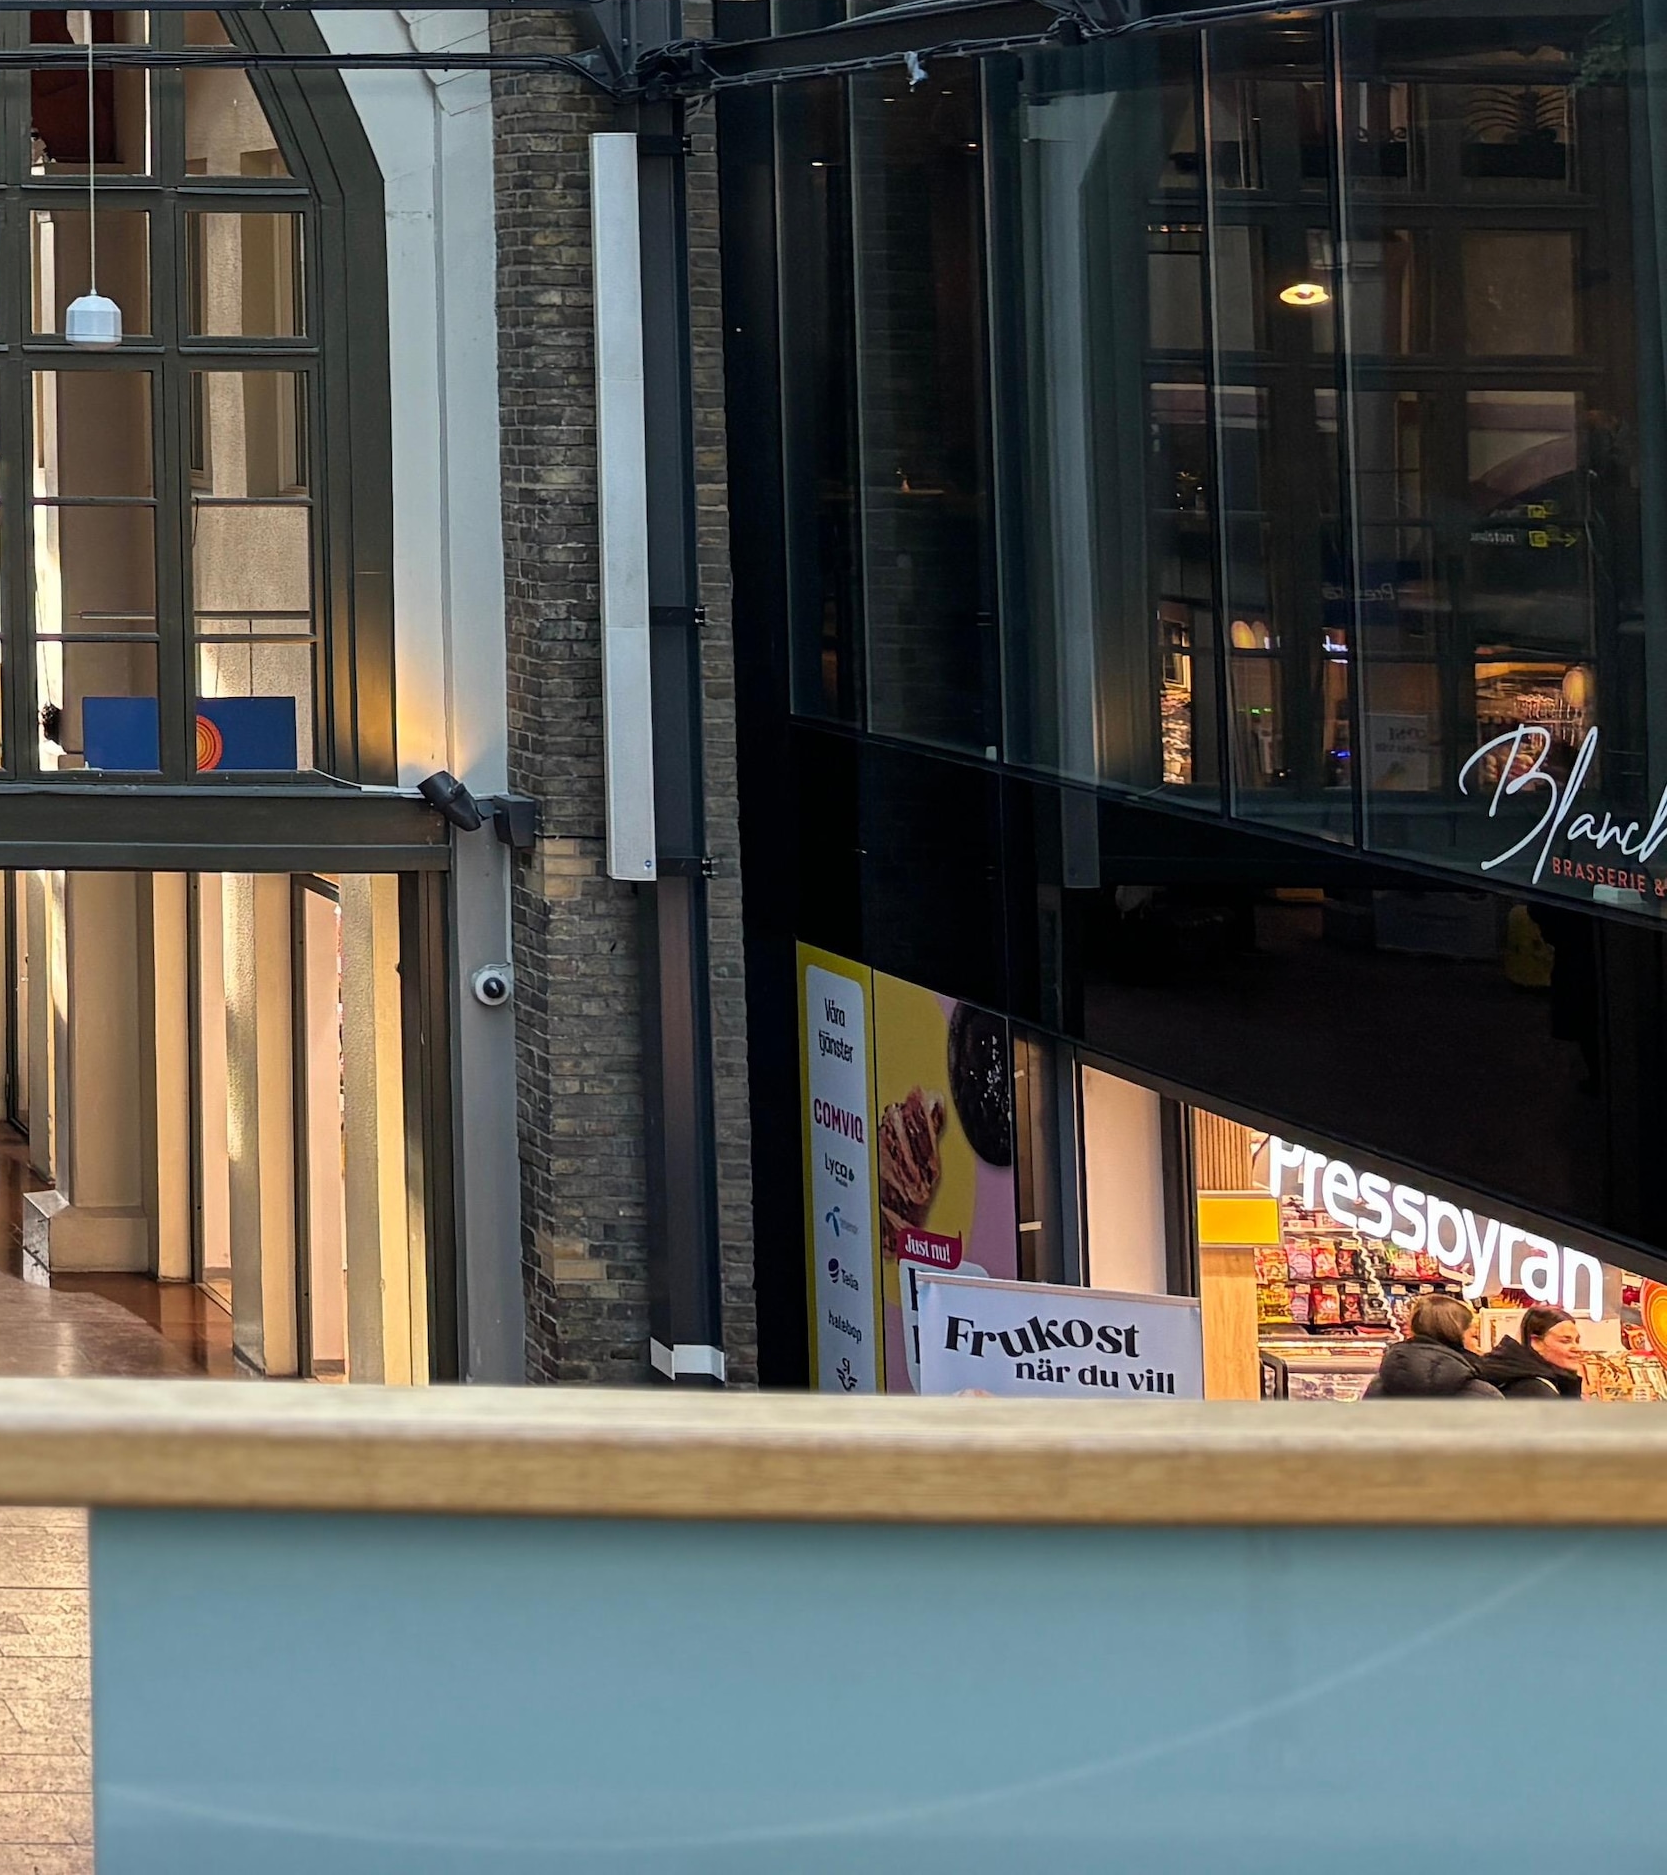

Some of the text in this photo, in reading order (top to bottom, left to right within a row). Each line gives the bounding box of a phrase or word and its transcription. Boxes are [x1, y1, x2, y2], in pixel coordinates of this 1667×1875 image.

[1552, 856, 1647, 893] BRASSERIE
[824, 997, 846, 1028] Våra
[818, 1029, 854, 1063] tjänster
[814, 1097, 865, 1145] COMVIQ
[824, 1152, 848, 1180] Lyca
[904, 1233, 951, 1263] Just nu!
[944, 1315, 1140, 1359] Frukost
[1016, 1357, 1176, 1395] när du vill
